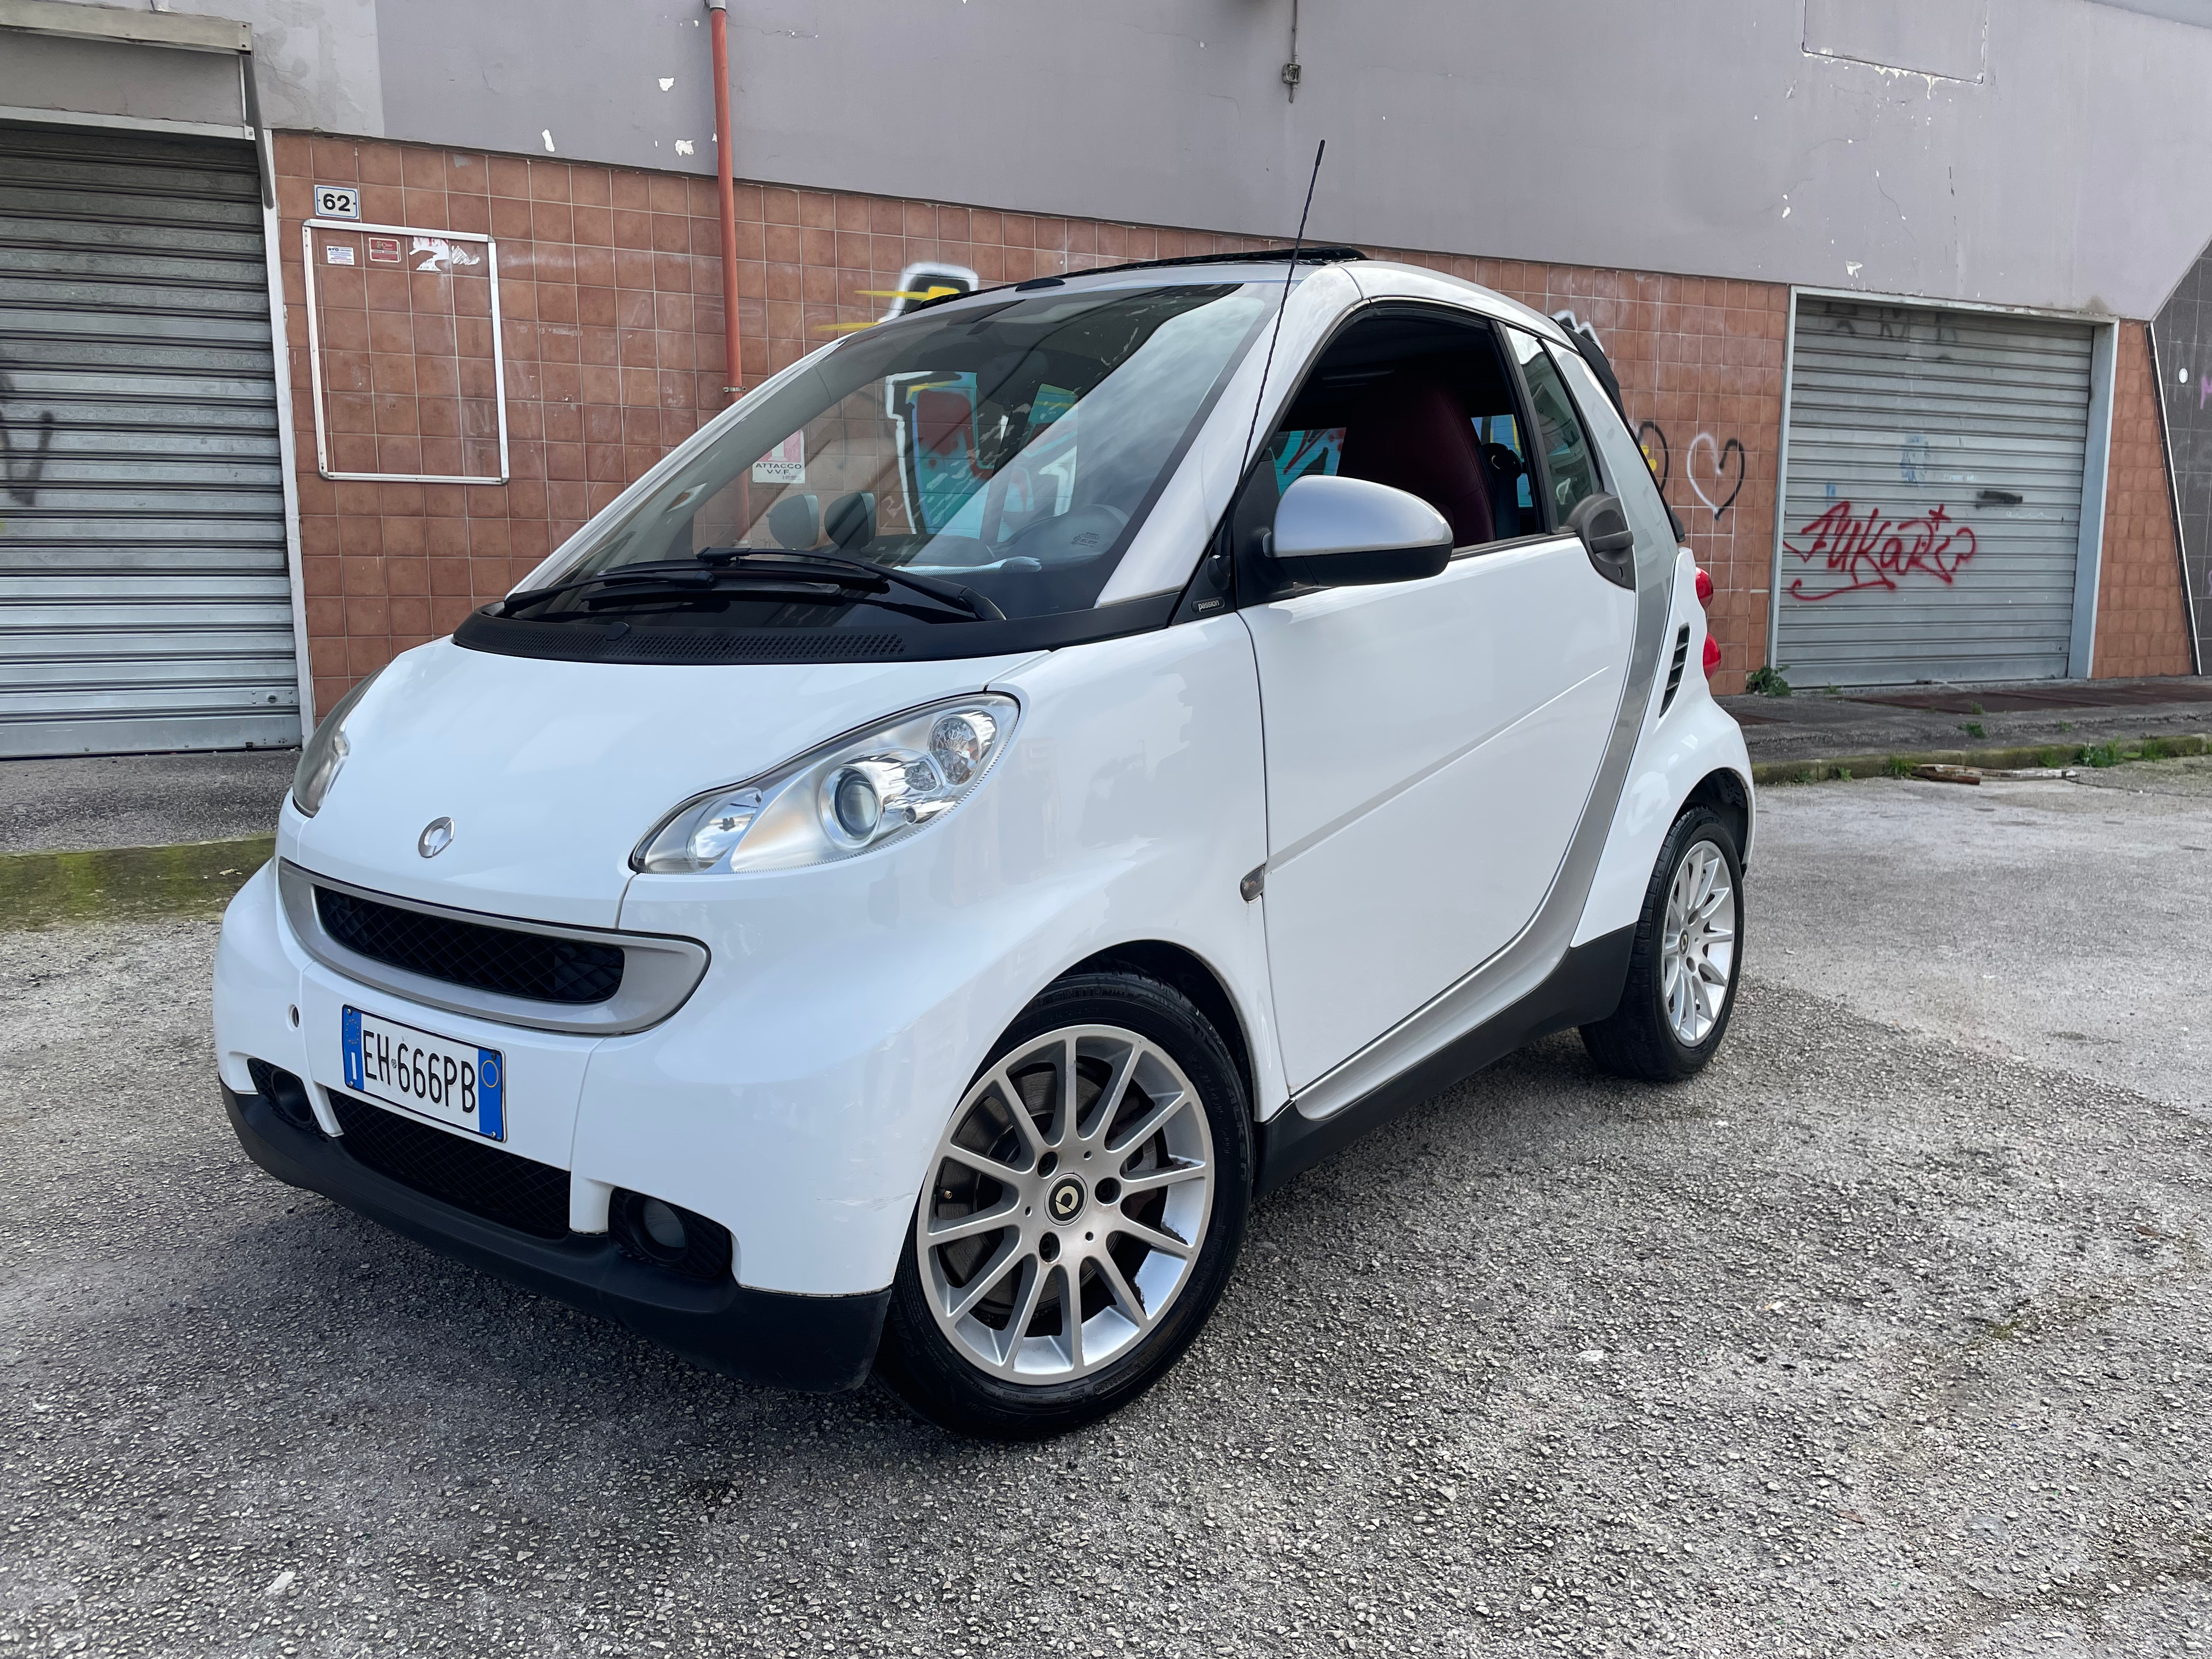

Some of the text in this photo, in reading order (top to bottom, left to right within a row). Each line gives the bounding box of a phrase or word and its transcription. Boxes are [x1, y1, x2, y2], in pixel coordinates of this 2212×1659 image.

[323, 193, 351, 212] 62
[1198, 600, 1220, 612] passion
[363, 1029, 476, 1114] EH 666PB
